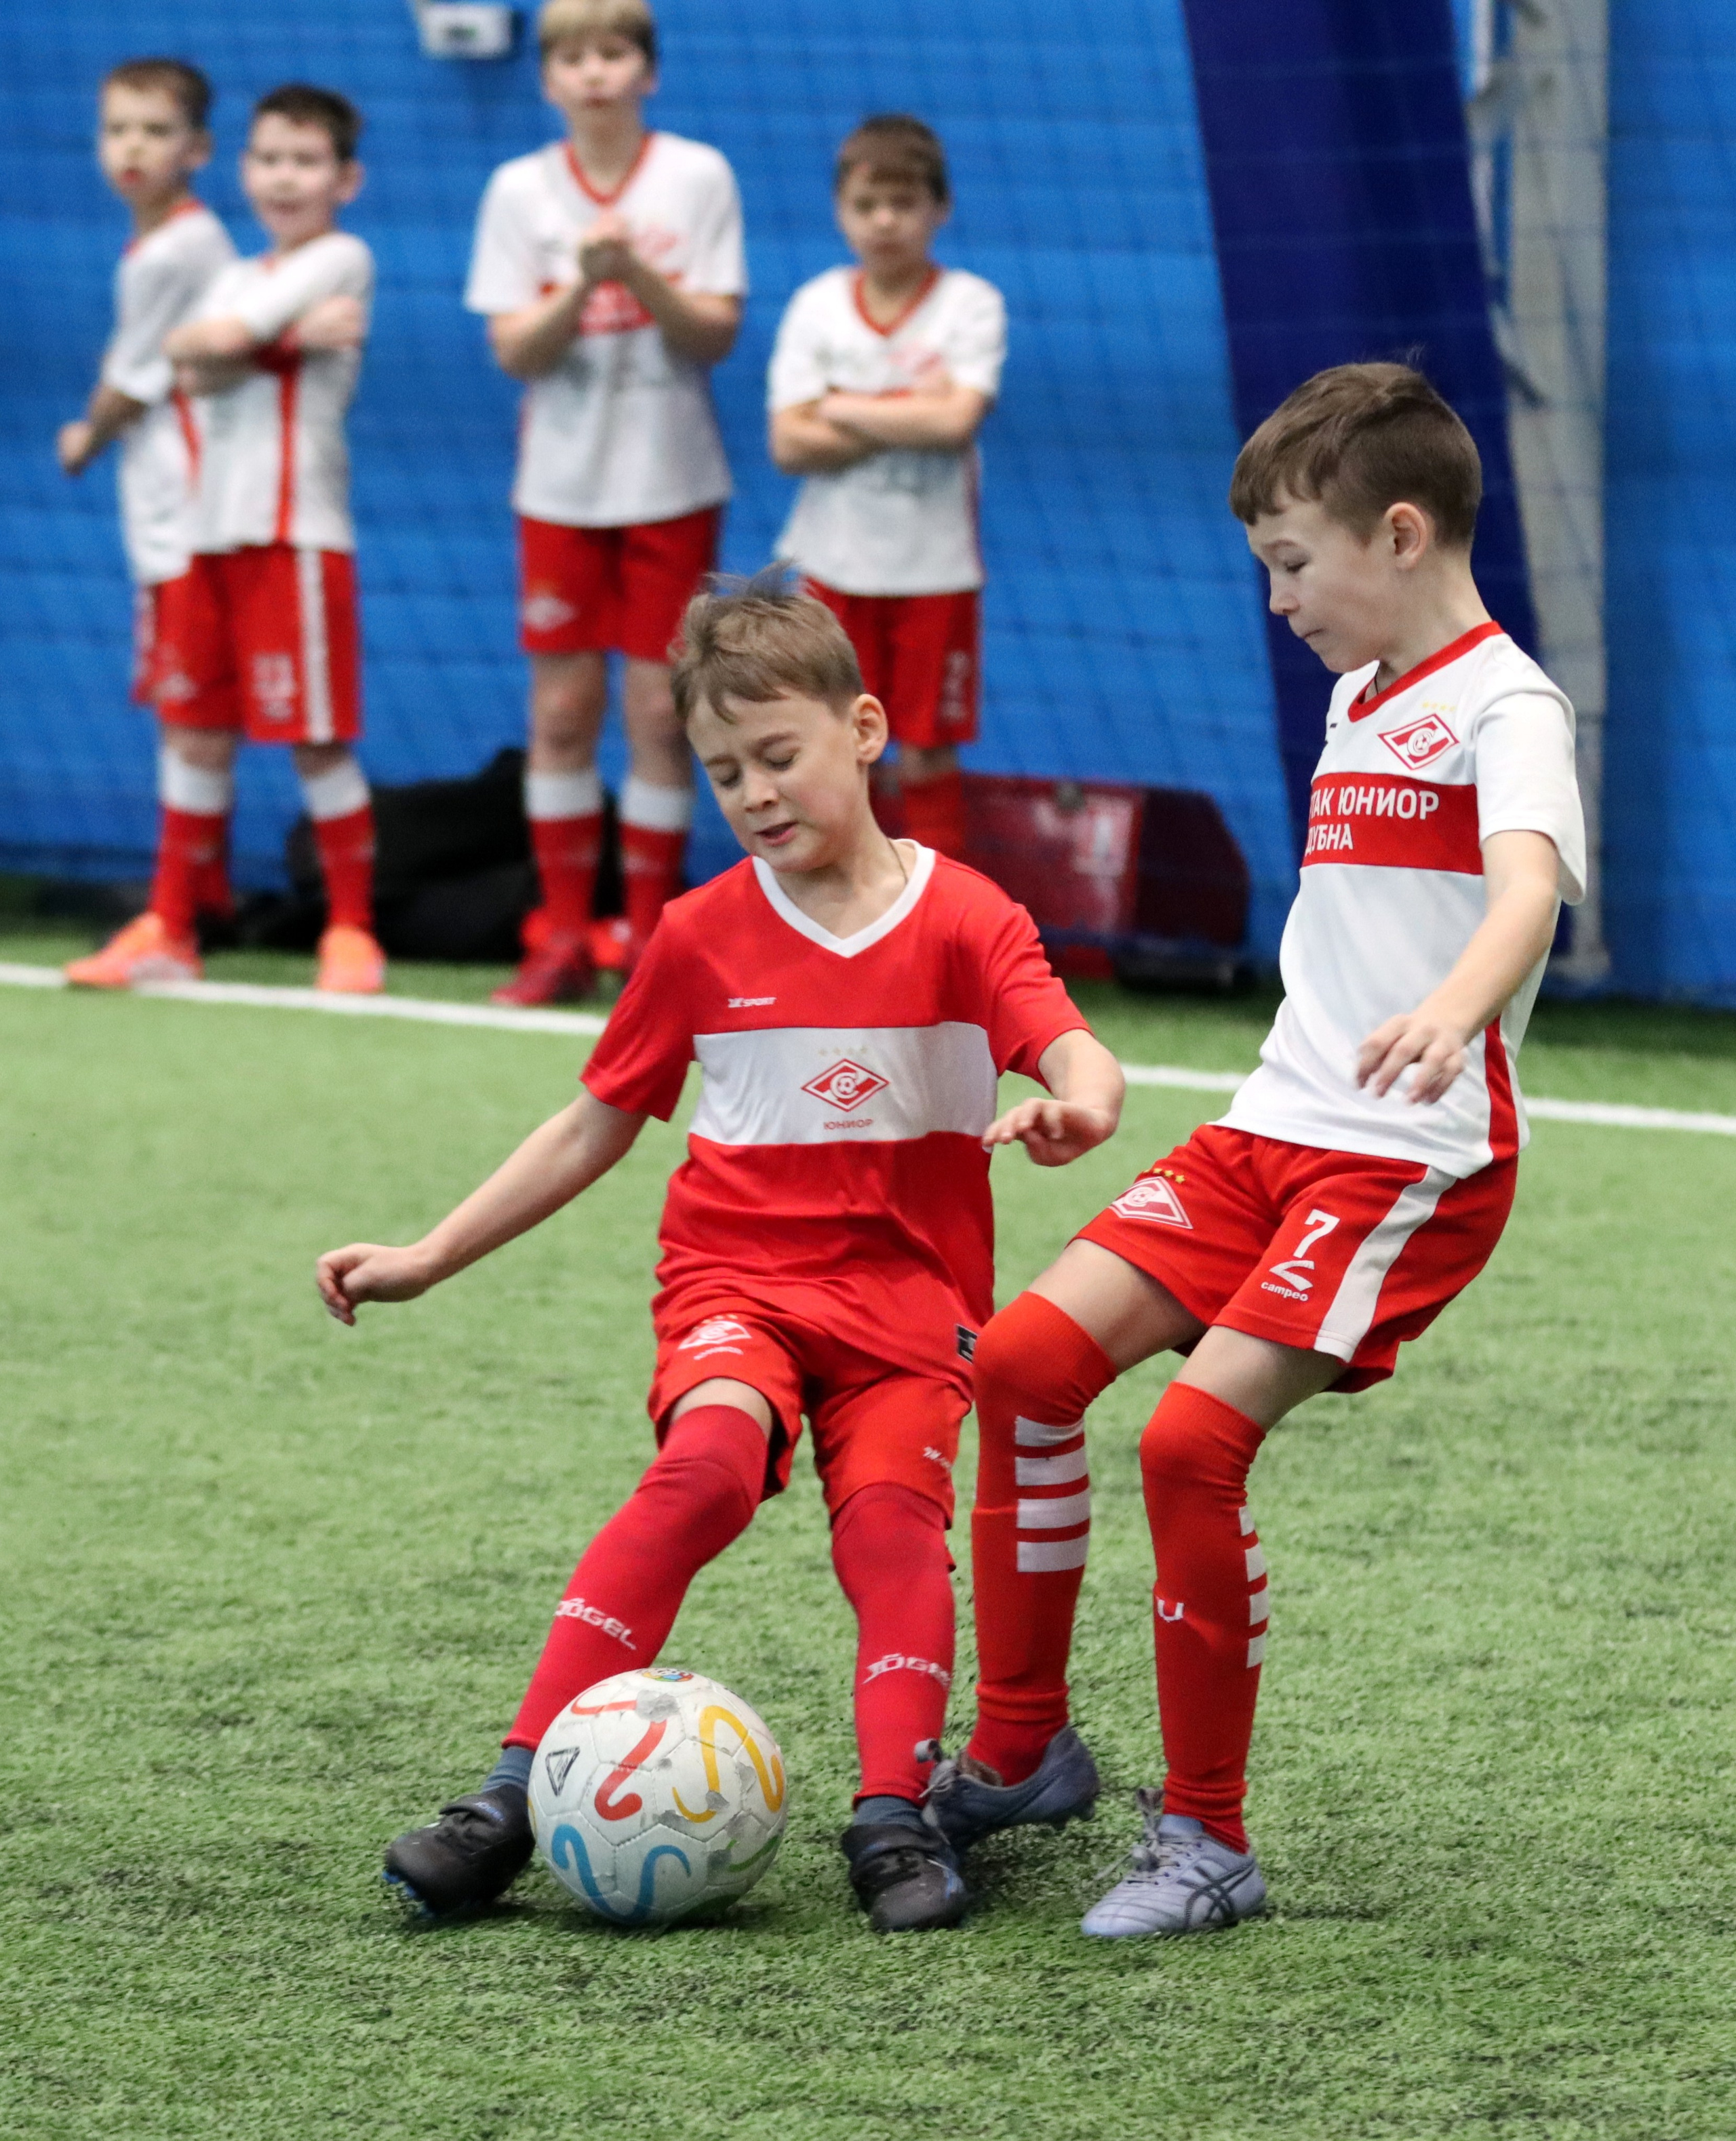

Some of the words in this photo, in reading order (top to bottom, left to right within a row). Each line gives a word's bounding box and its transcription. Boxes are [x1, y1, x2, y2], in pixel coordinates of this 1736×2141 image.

[1337, 785, 1440, 821] ЮНИОР
[1304, 823, 1354, 857] ДУБНА
[823, 1118, 873, 1131] ЮНИОР
[1293, 1208, 1341, 1259] 7
[1261, 1281, 1309, 1301] campeo
